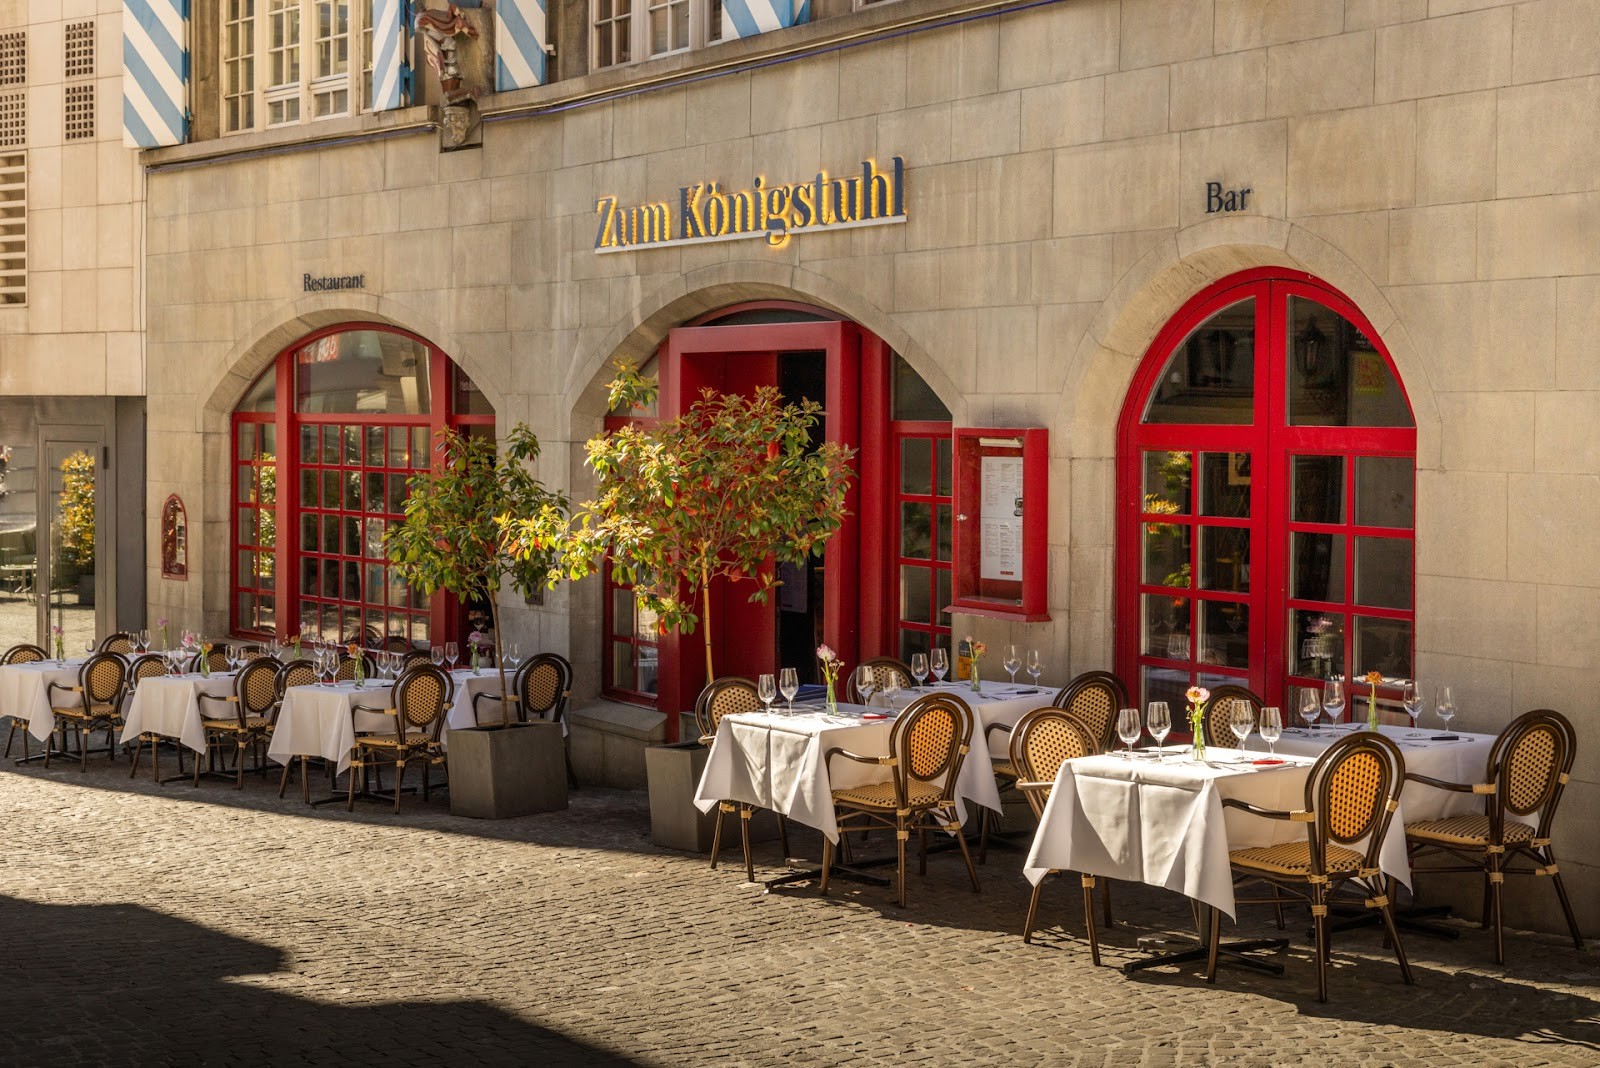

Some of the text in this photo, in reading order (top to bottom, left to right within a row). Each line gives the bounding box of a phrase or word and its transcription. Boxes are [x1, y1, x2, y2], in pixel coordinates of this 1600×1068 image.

[594, 156, 904, 248] Zum Königstuhl
[1205, 181, 1251, 214] Bar
[303, 273, 365, 292] Restaurant
